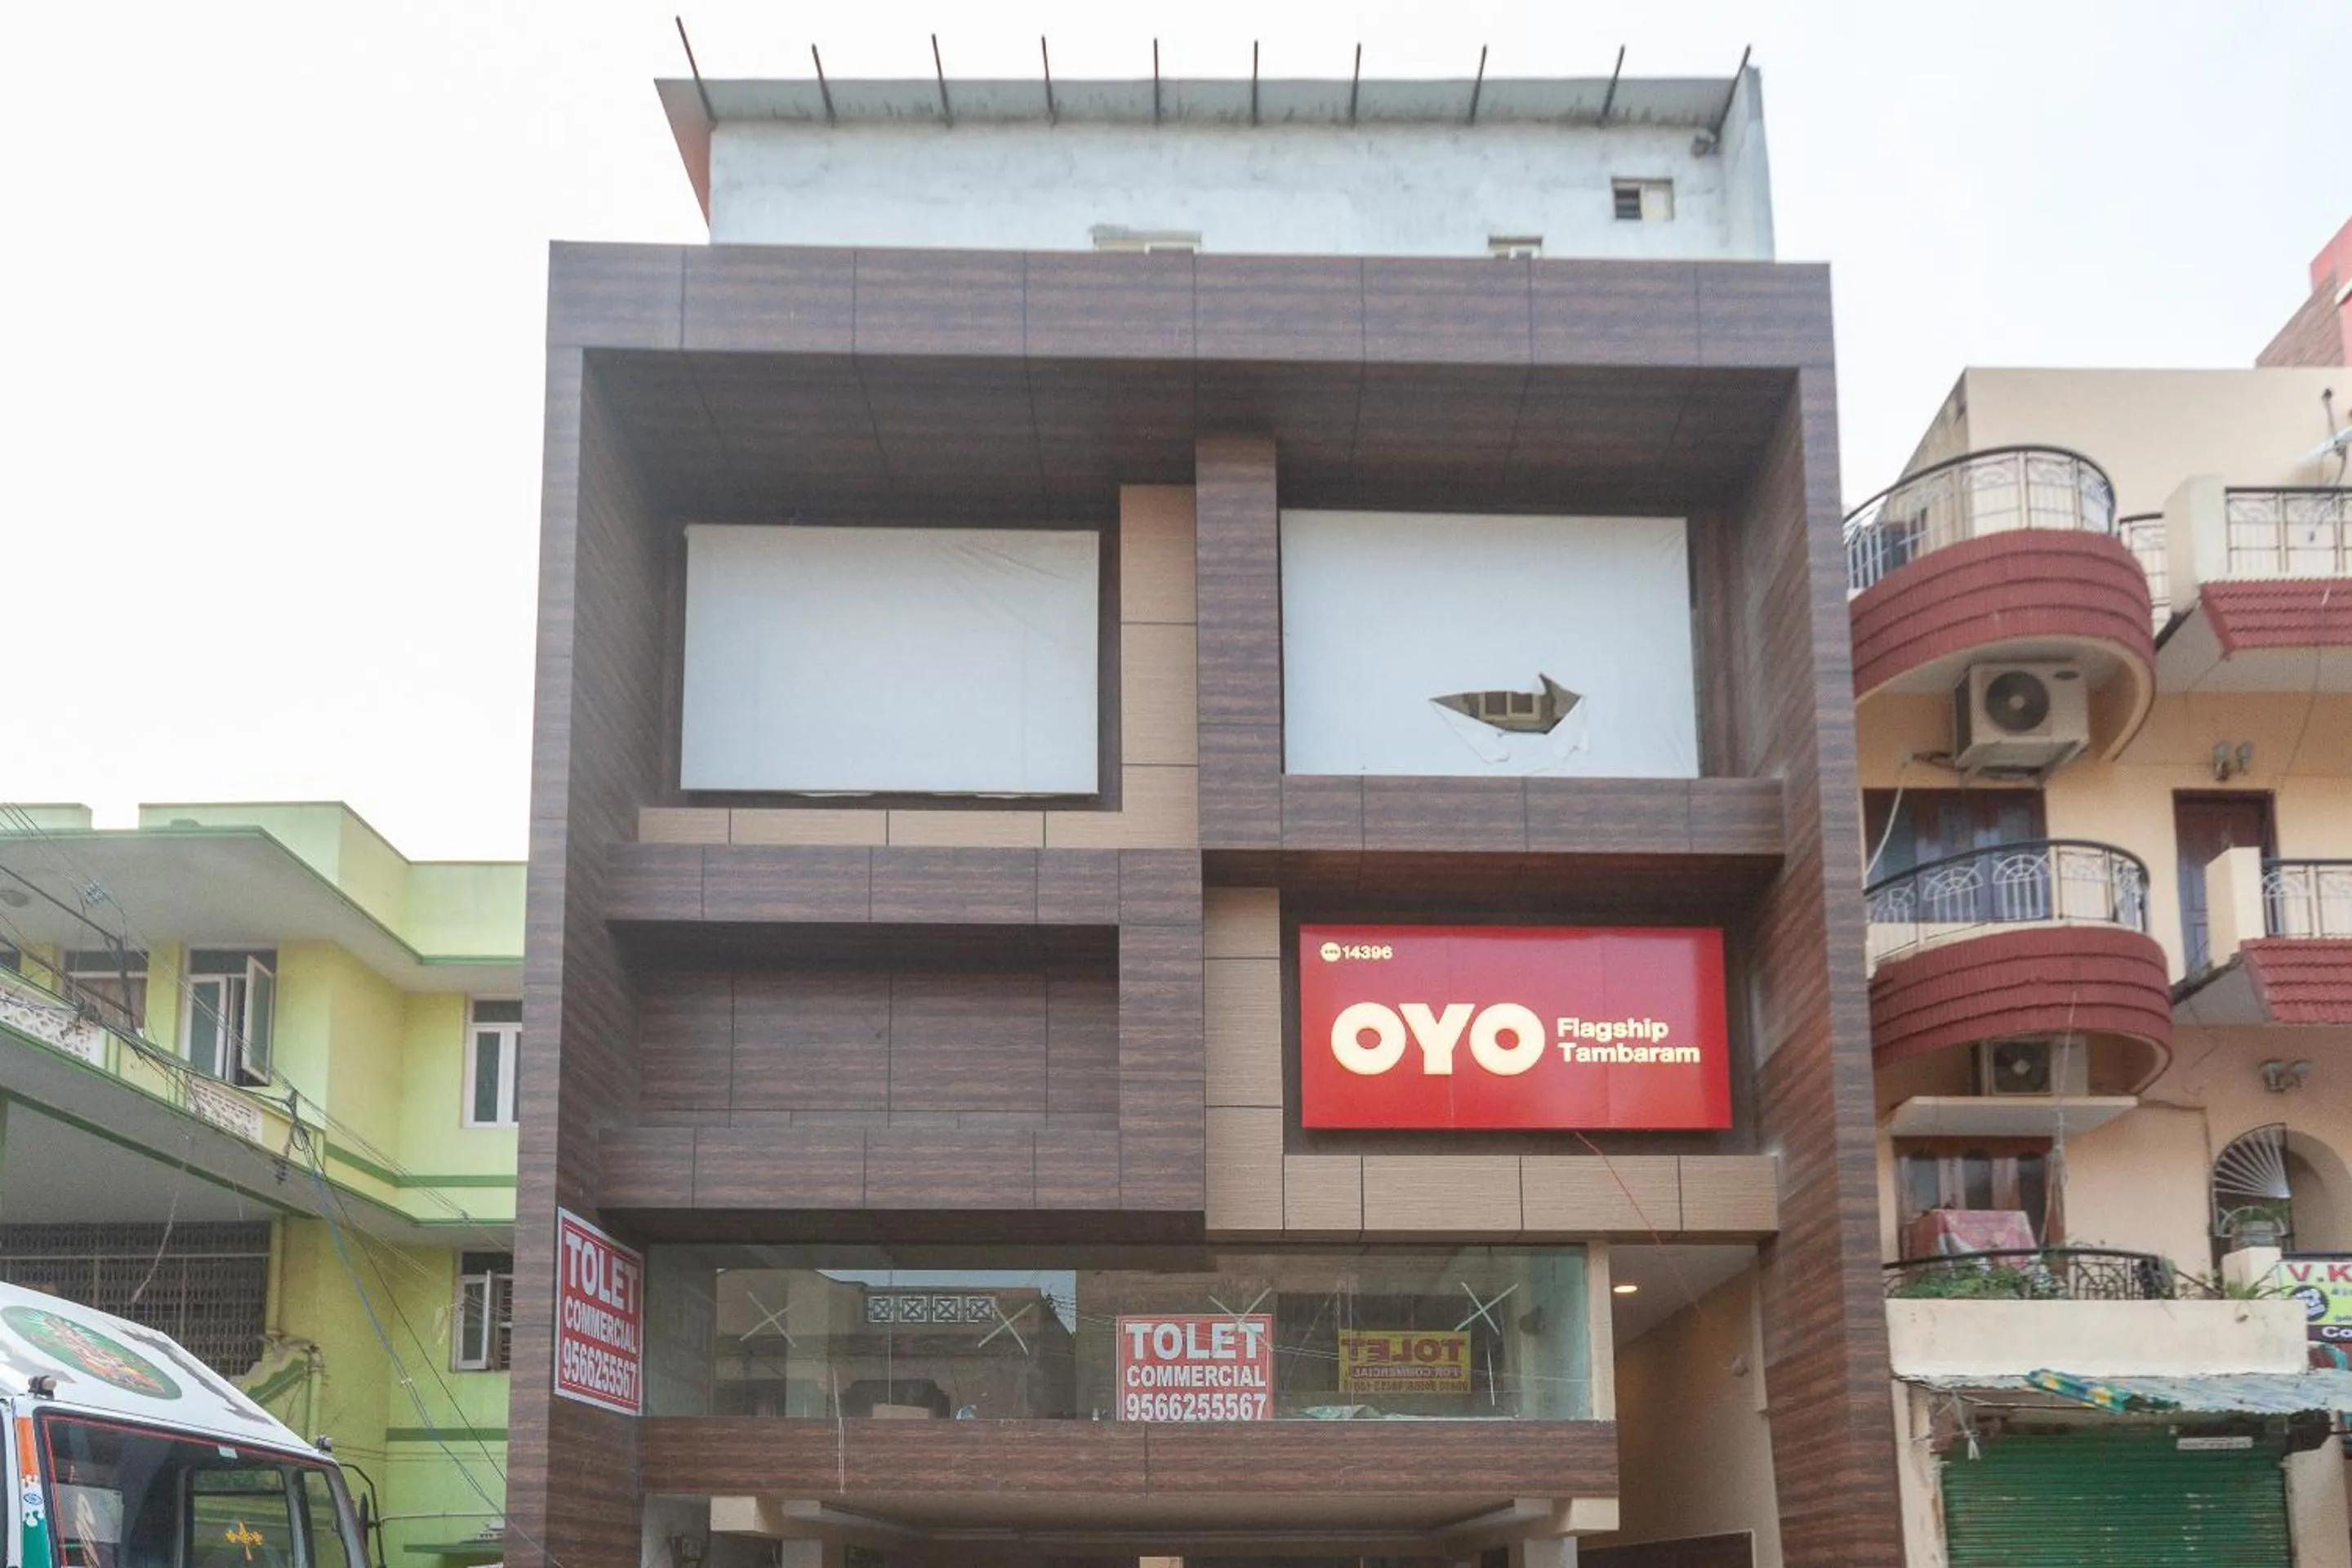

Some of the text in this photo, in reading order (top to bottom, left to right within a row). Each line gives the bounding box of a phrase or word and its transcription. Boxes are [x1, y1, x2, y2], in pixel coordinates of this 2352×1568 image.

[1342, 945, 1393, 960] 14396
[1330, 1002, 1545, 1076] OYO
[1557, 1018, 1669, 1043] Flagship
[1557, 1042, 1701, 1062] Tambaram
[565, 1231, 638, 1314] TOLET
[564, 1295, 637, 1354] COMMERCIAL
[1125, 1323, 1265, 1360] TOLET
[563, 1337, 637, 1399] 9566255567
[1126, 1365, 1267, 1387] COMMERCIAL
[1125, 1392, 1267, 1421] 9566255567
